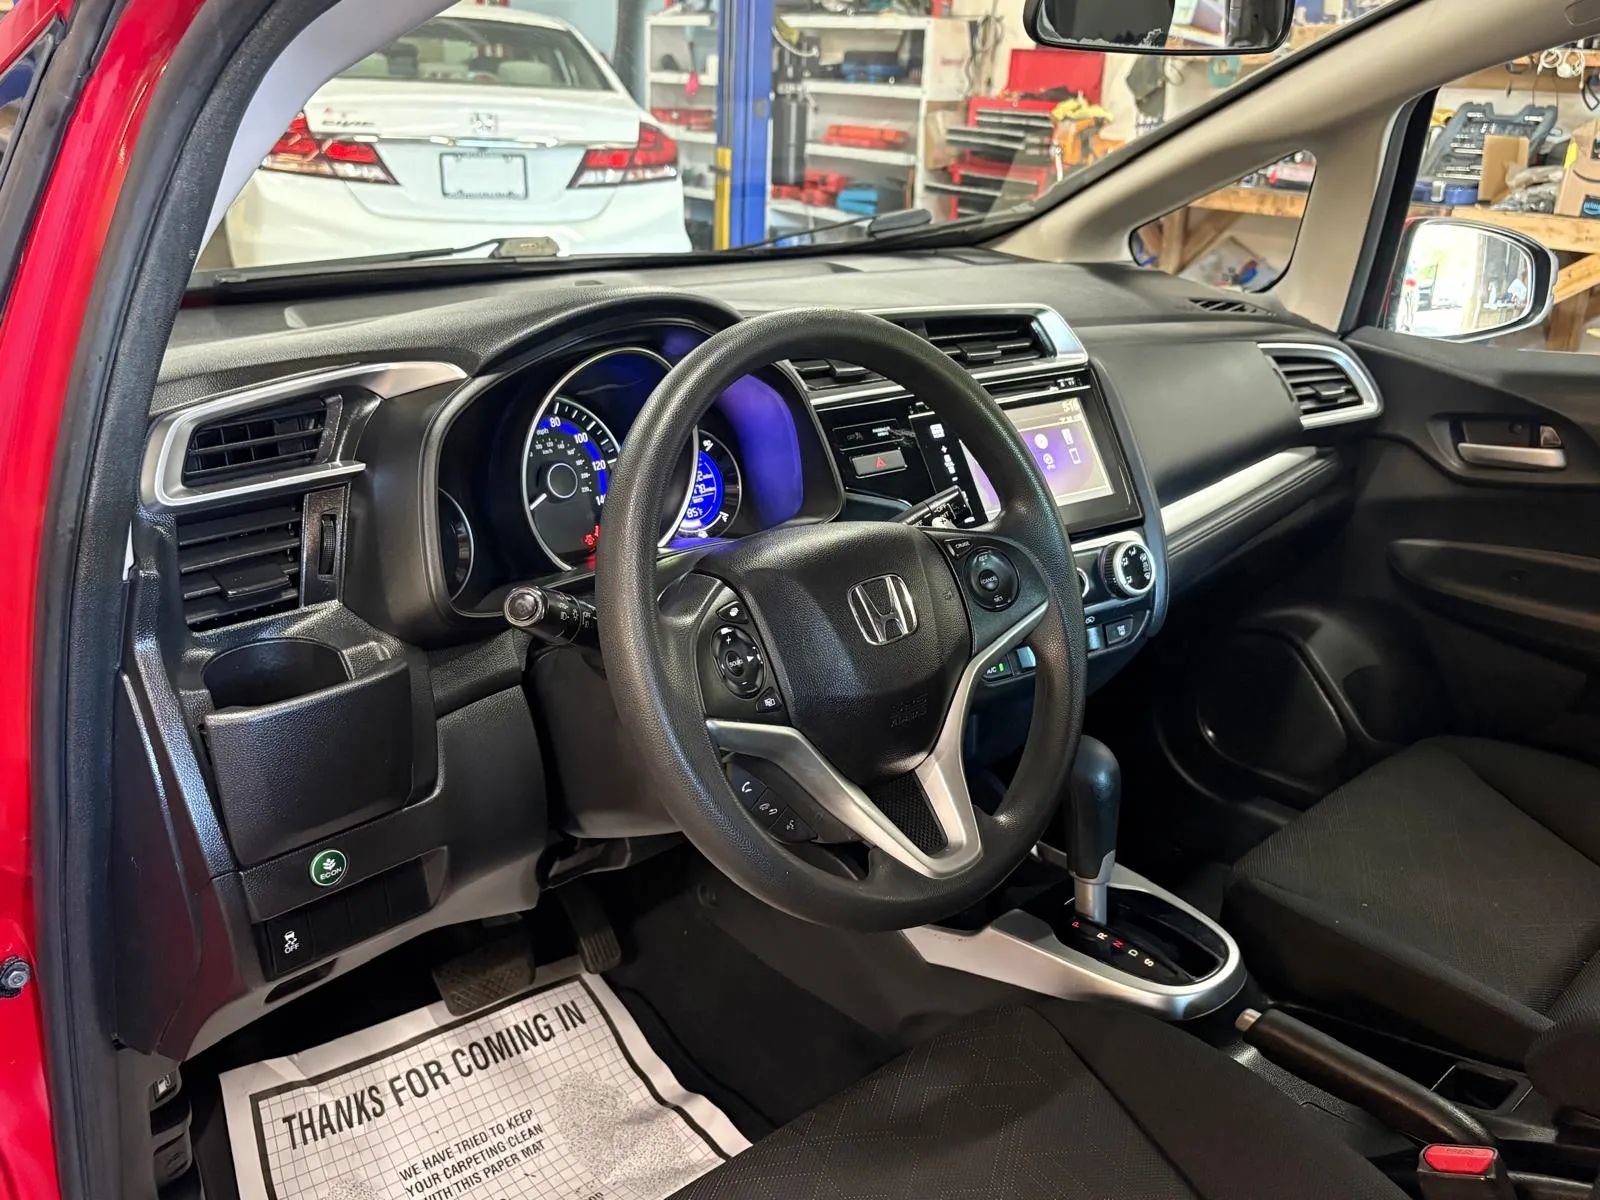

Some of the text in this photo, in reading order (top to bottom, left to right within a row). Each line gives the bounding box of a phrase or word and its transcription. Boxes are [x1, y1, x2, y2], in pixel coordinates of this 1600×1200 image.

[550, 417, 560, 427] 80
[574, 432, 588, 443] 100
[592, 460, 606, 471] 120
[320, 867, 342, 880] ECON
[284, 942, 299, 954] OFF
[1096, 932, 1108, 940] R
[1112, 940, 1123, 948] N
[1128, 949, 1138, 957] D
[1144, 958, 1154, 967] S
[282, 1001, 587, 1150] THANKS FOR COMING IN
[399, 1108, 533, 1181] WE HAVE TRIED TO KEEP
[405, 1123, 544, 1198] YOUR CARPETING CLEAN
[452, 1172, 482, 1193] THIS
[482, 1153, 521, 1179] PAPER
[521, 1139, 546, 1159] MAT
